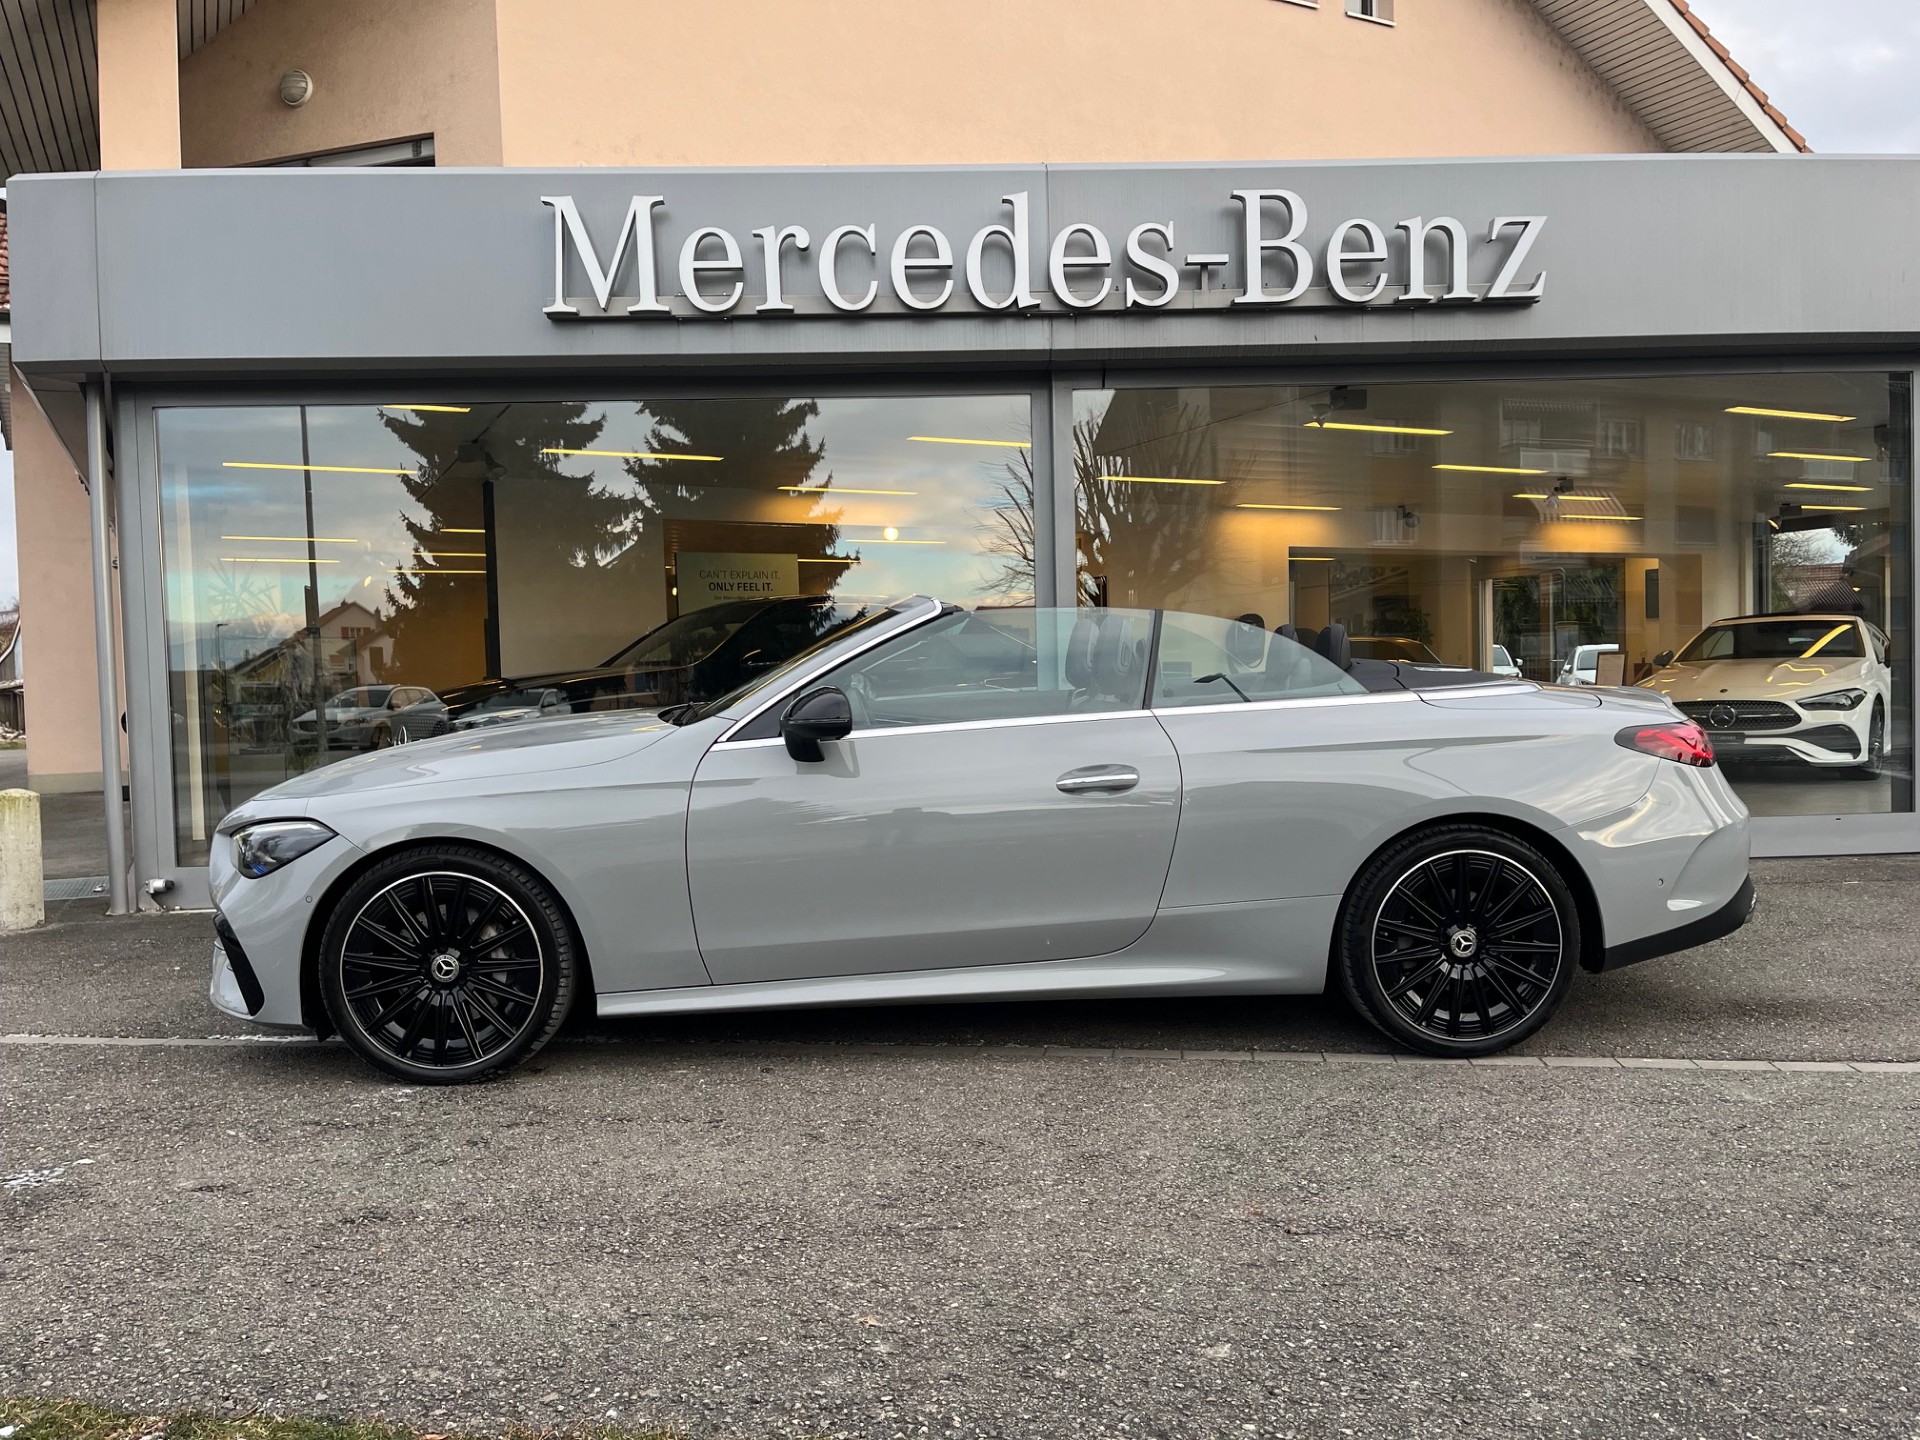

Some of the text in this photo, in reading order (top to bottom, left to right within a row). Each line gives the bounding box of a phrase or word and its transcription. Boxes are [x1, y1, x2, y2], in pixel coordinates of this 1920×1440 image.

[540, 189, 1548, 315] Mercedes-Benz
[699, 570, 728, 580] CAN'T
[730, 570, 769, 580] EXPLAIN
[708, 582, 774, 592] ONLY FEEL IT.
